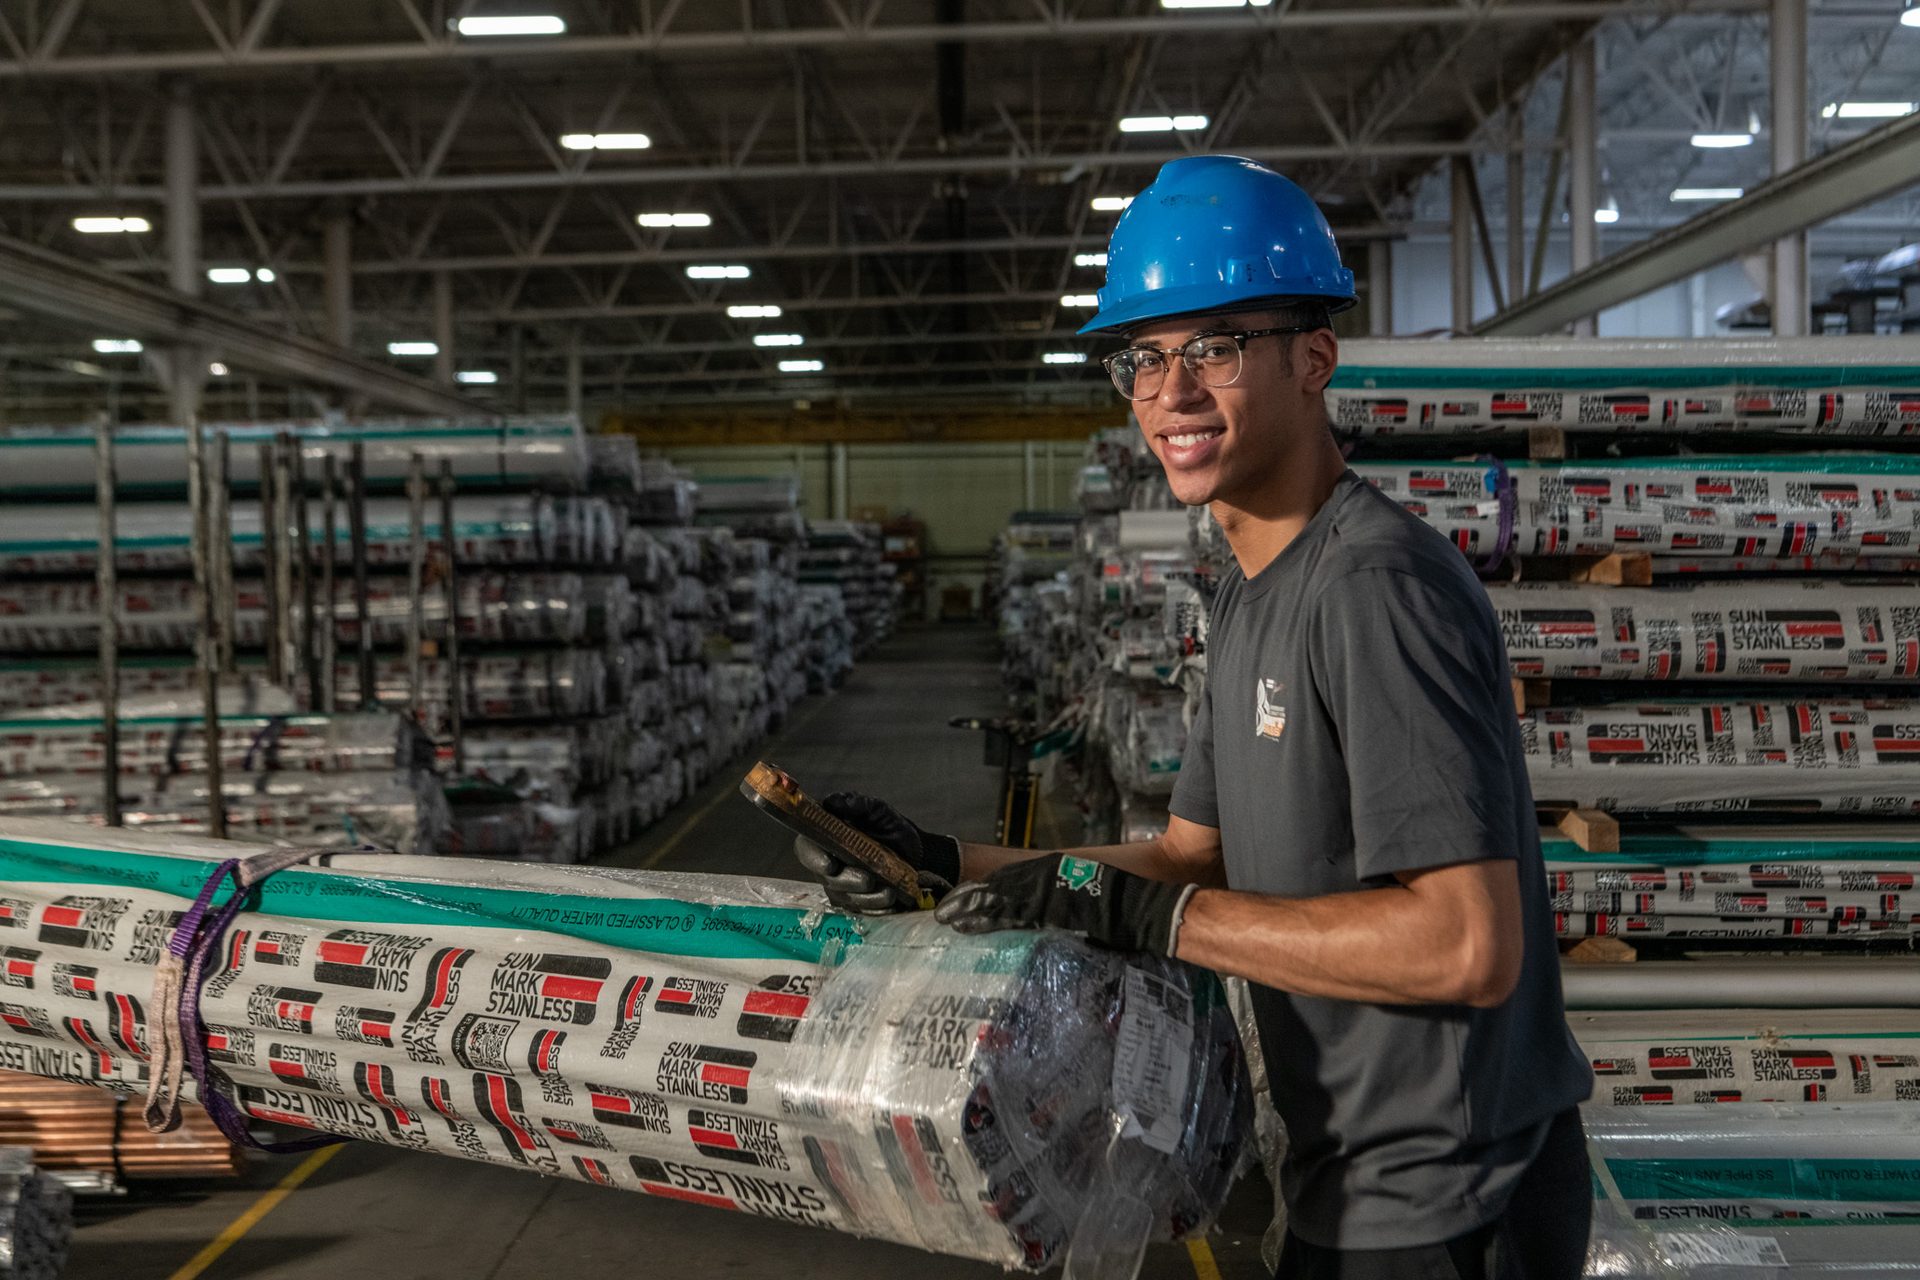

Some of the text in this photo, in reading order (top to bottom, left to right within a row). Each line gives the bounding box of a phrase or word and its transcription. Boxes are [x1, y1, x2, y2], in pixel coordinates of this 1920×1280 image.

[1729, 610, 1764, 623] SUN
[1505, 637, 1575, 649] AINLESS
[1733, 637, 1823, 650] STAINLESS
[1609, 724, 1697, 738] STAINLESS
[1649, 740, 1698, 751] MARK
[1664, 752, 1700, 765] SUN
[84, 913, 123, 931] MARK
[138, 909, 171, 926] SUN
[507, 906, 561, 923] QUALITY
[561, 910, 605, 927] WATER
[606, 913, 679, 930] CLASSIFIED
[88, 930, 116, 951] SUN
[133, 925, 172, 947] MARK
[344, 930, 433, 950] STAINLESS
[767, 925, 783, 938] 61
[125, 945, 160, 965] STAIN
[366, 946, 418, 969] MARK
[498, 952, 541, 971] SUN
[377, 968, 409, 992] SUN
[491, 968, 543, 995] MARK
[677, 977, 729, 995] STAINLESS
[252, 983, 280, 1001] SUN
[692, 992, 724, 1006] MARK
[248, 996, 279, 1014] MARK
[337, 1005, 359, 1017] SUN
[486, 992, 573, 1024] STAINLESS
[696, 1004, 720, 1019] SUN
[248, 1011, 299, 1033] STAINLESS
[335, 1017, 361, 1031] MARK
[426, 967, 461, 1066] STAINLESS
[617, 992, 648, 1059] STAINLESS
[336, 1030, 383, 1047] STAINLESS
[608, 1021, 633, 1058] MARK
[902, 1016, 970, 1045] MARK
[228, 1035, 256, 1051] MARK
[401, 1025, 422, 1063] SUN
[600, 1031, 620, 1057] SUN
[663, 1042, 700, 1059] SUN
[1665, 1046, 1732, 1057] STAINLESS
[237, 1051, 256, 1066] SUN
[283, 1045, 337, 1067] STAINLESS
[1695, 1057, 1733, 1068] MARK
[1751, 1049, 1778, 1059] SUN
[658, 1056, 702, 1079] MARK
[1707, 1068, 1735, 1079] SUN
[1753, 1059, 1791, 1070] MARK
[1754, 1069, 1821, 1082] STAINLESS
[1895, 1080, 1915, 1088] SUN
[543, 1074, 553, 1103] SUN
[656, 1075, 729, 1102] STAINLESS
[1613, 1087, 1632, 1095] SUN
[1613, 1095, 1642, 1103] MARK
[268, 1089, 377, 1129] STAINLESS
[633, 1099, 668, 1119] MARK
[646, 1119, 671, 1134] SUN
[706, 1113, 778, 1139] STAINLESS
[742, 1135, 785, 1156] MARK
[760, 1153, 791, 1171] SUN
[664, 1161, 824, 1210] STAINLESS
